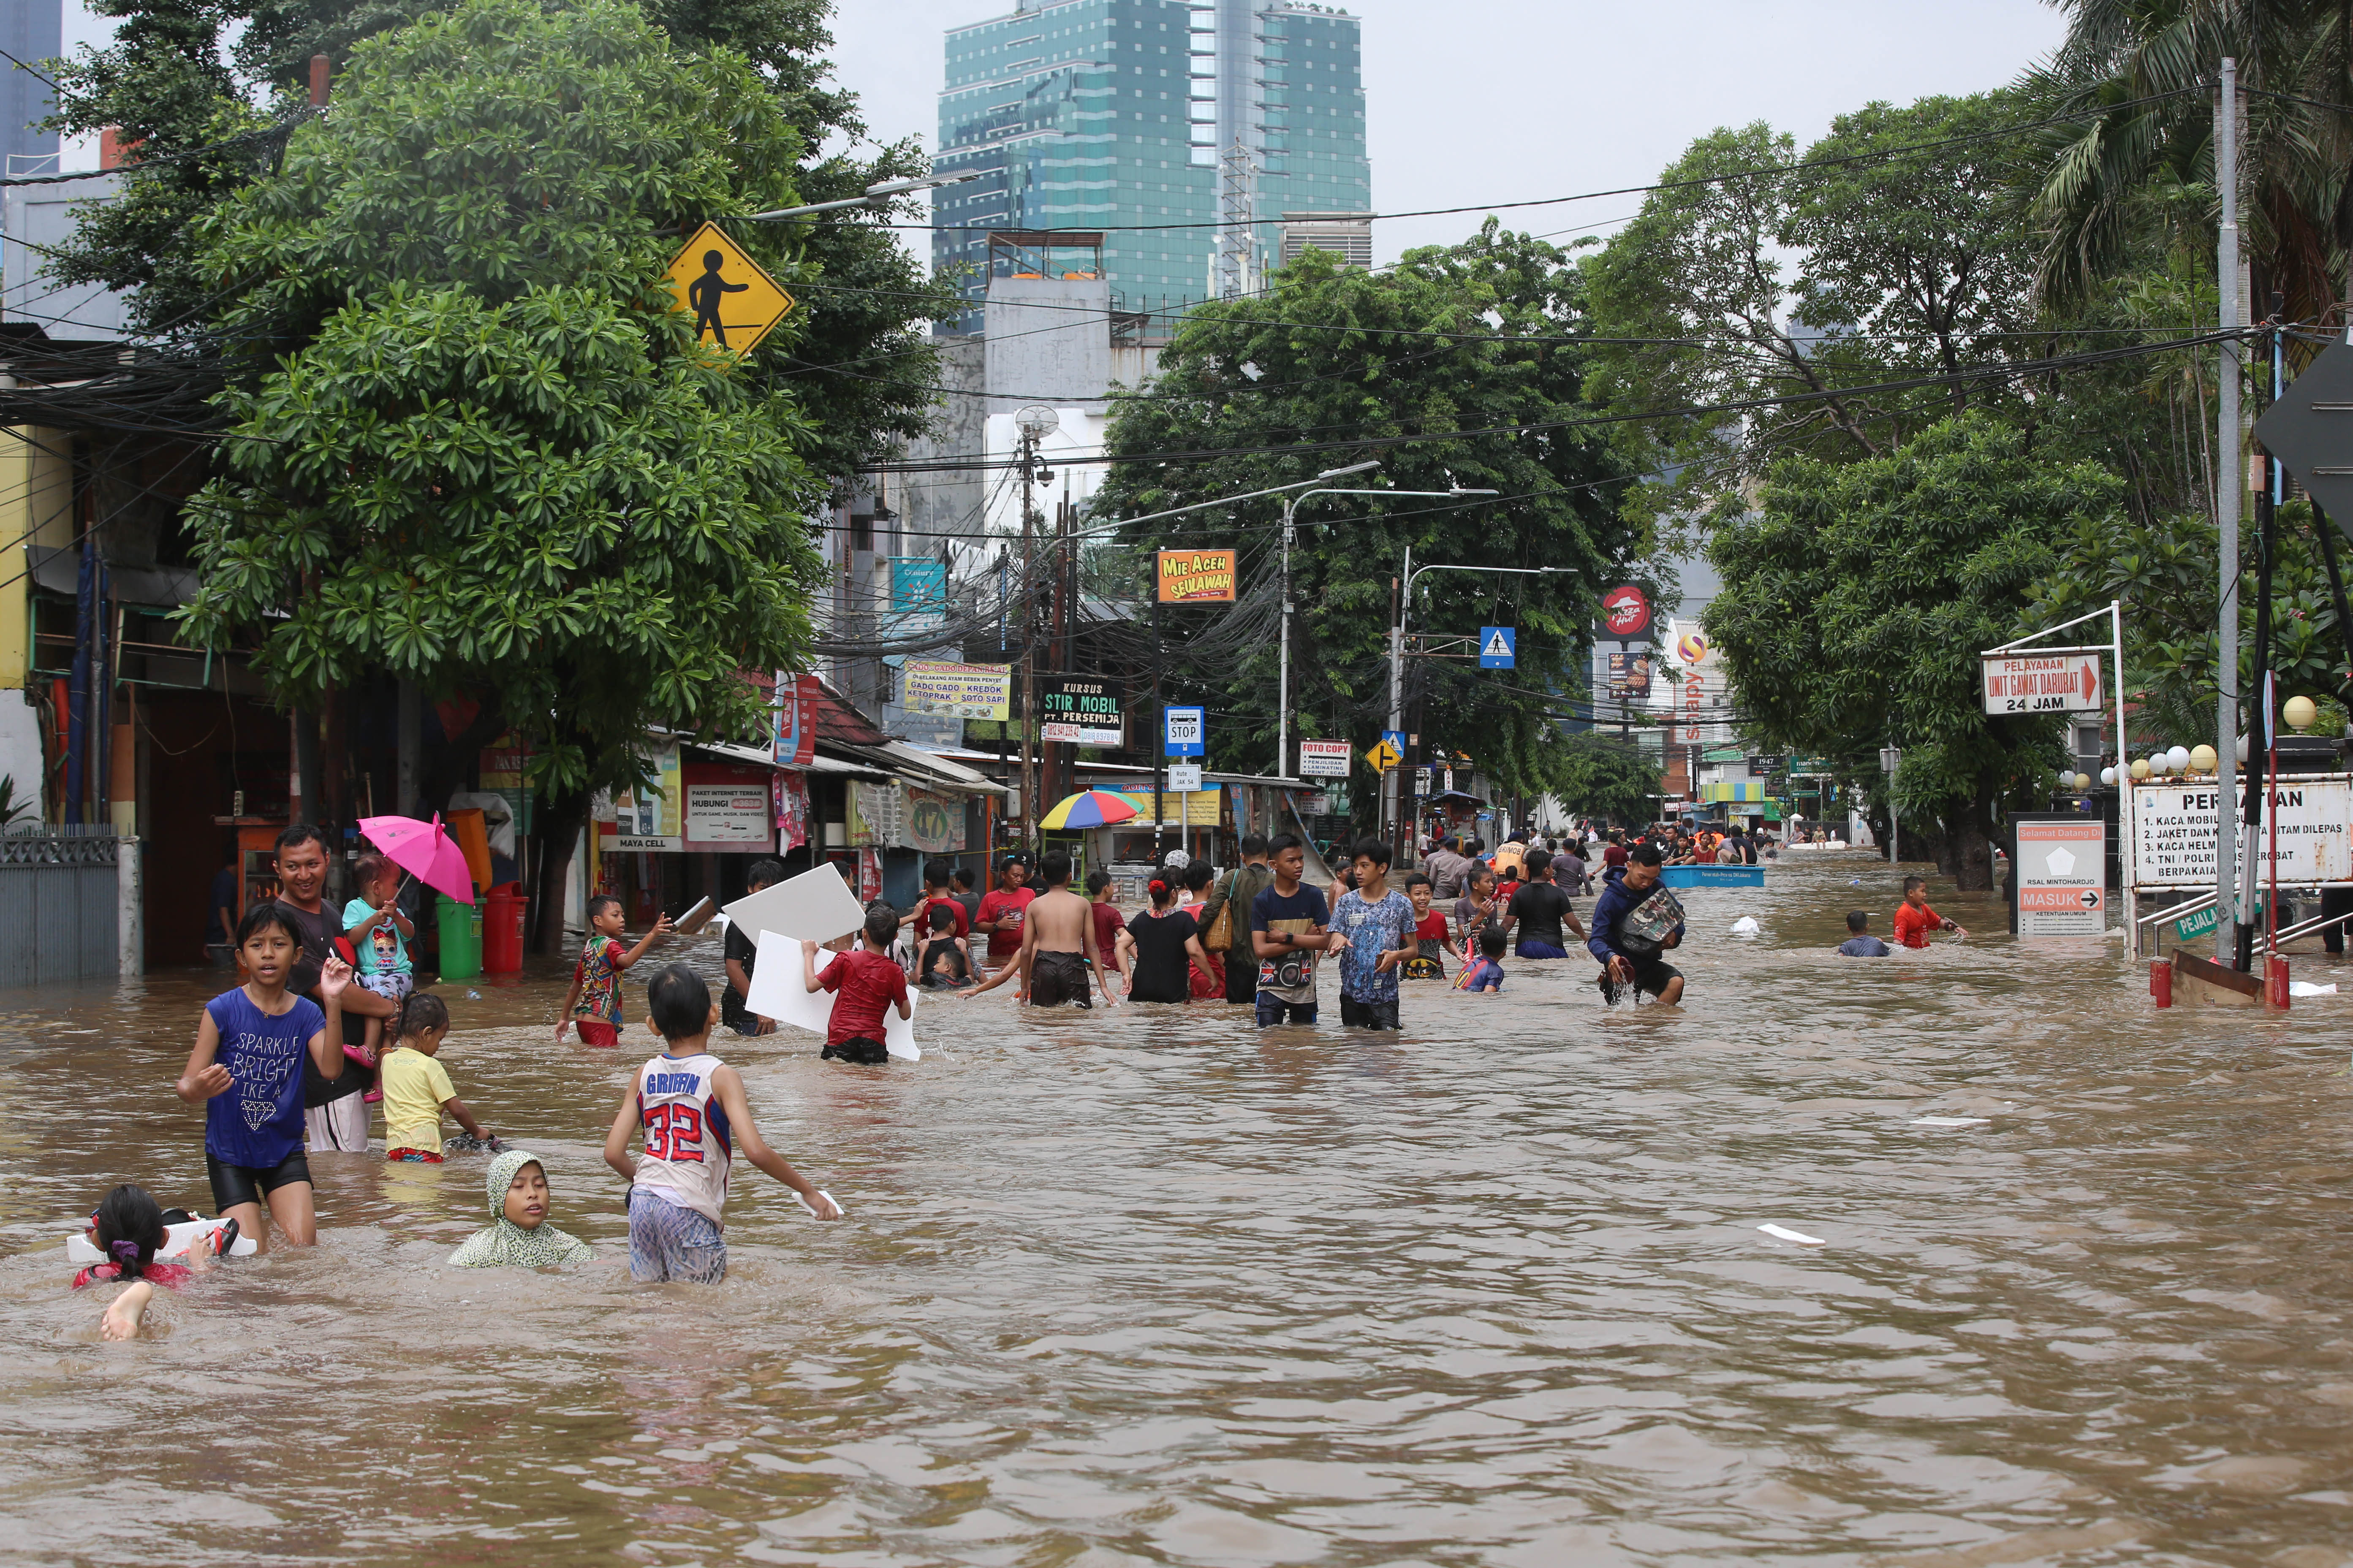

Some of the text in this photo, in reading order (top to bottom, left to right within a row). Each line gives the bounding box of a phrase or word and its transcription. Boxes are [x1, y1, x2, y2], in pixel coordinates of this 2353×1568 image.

[905, 569, 934, 577] Century
[1171, 573, 1232, 599] SEULAWAH
[2004, 659, 2063, 672] PELAYANAN
[911, 681, 933, 690] GADO
[967, 685, 1002, 693] KREDOK
[1063, 683, 1103, 694] KURSUS
[1989, 672, 2078, 697] UNIT GAWAT DARURAT
[908, 690, 951, 700] KETOPRAK
[1045, 694, 1119, 713] STIR MOBIL
[2007, 697, 2063, 711] 24 JAM
[1063, 712, 1119, 724] PERSEMIJA
[1172, 727, 1196, 737] STOP
[1303, 744, 1348, 753] FOTO COPY
[2183, 791, 2302, 809] PERIAN
[2144, 815, 2218, 826] 1. KACA MOBIL
[2058, 829, 2089, 838] Datang
[2144, 830, 2153, 838] 2.
[2157, 829, 2187, 838] JAKET
[2191, 829, 2211, 837] DAN
[2277, 825, 2300, 834] ITAM
[2303, 824, 2342, 834] DILEPAS
[1498, 846, 1521, 855] BRIMOB
[2145, 841, 2216, 852] 3. KACA HELM
[2145, 856, 2154, 864] 4.
[2158, 855, 2174, 864] TNI
[2185, 854, 2214, 863] POLRI
[2257, 851, 2293, 860] ERBAT
[2159, 867, 2216, 876] BERPAKAIA
[2023, 893, 2076, 906] MASUK
[2179, 907, 2217, 934] PEJALA
[1453, 970, 1470, 988] 10
[237, 1032, 299, 1055] SPARKLE
[233, 1053, 297, 1082] BRIGHT
[235, 1080, 280, 1099] IKE A
[644, 1103, 704, 1163] 32
